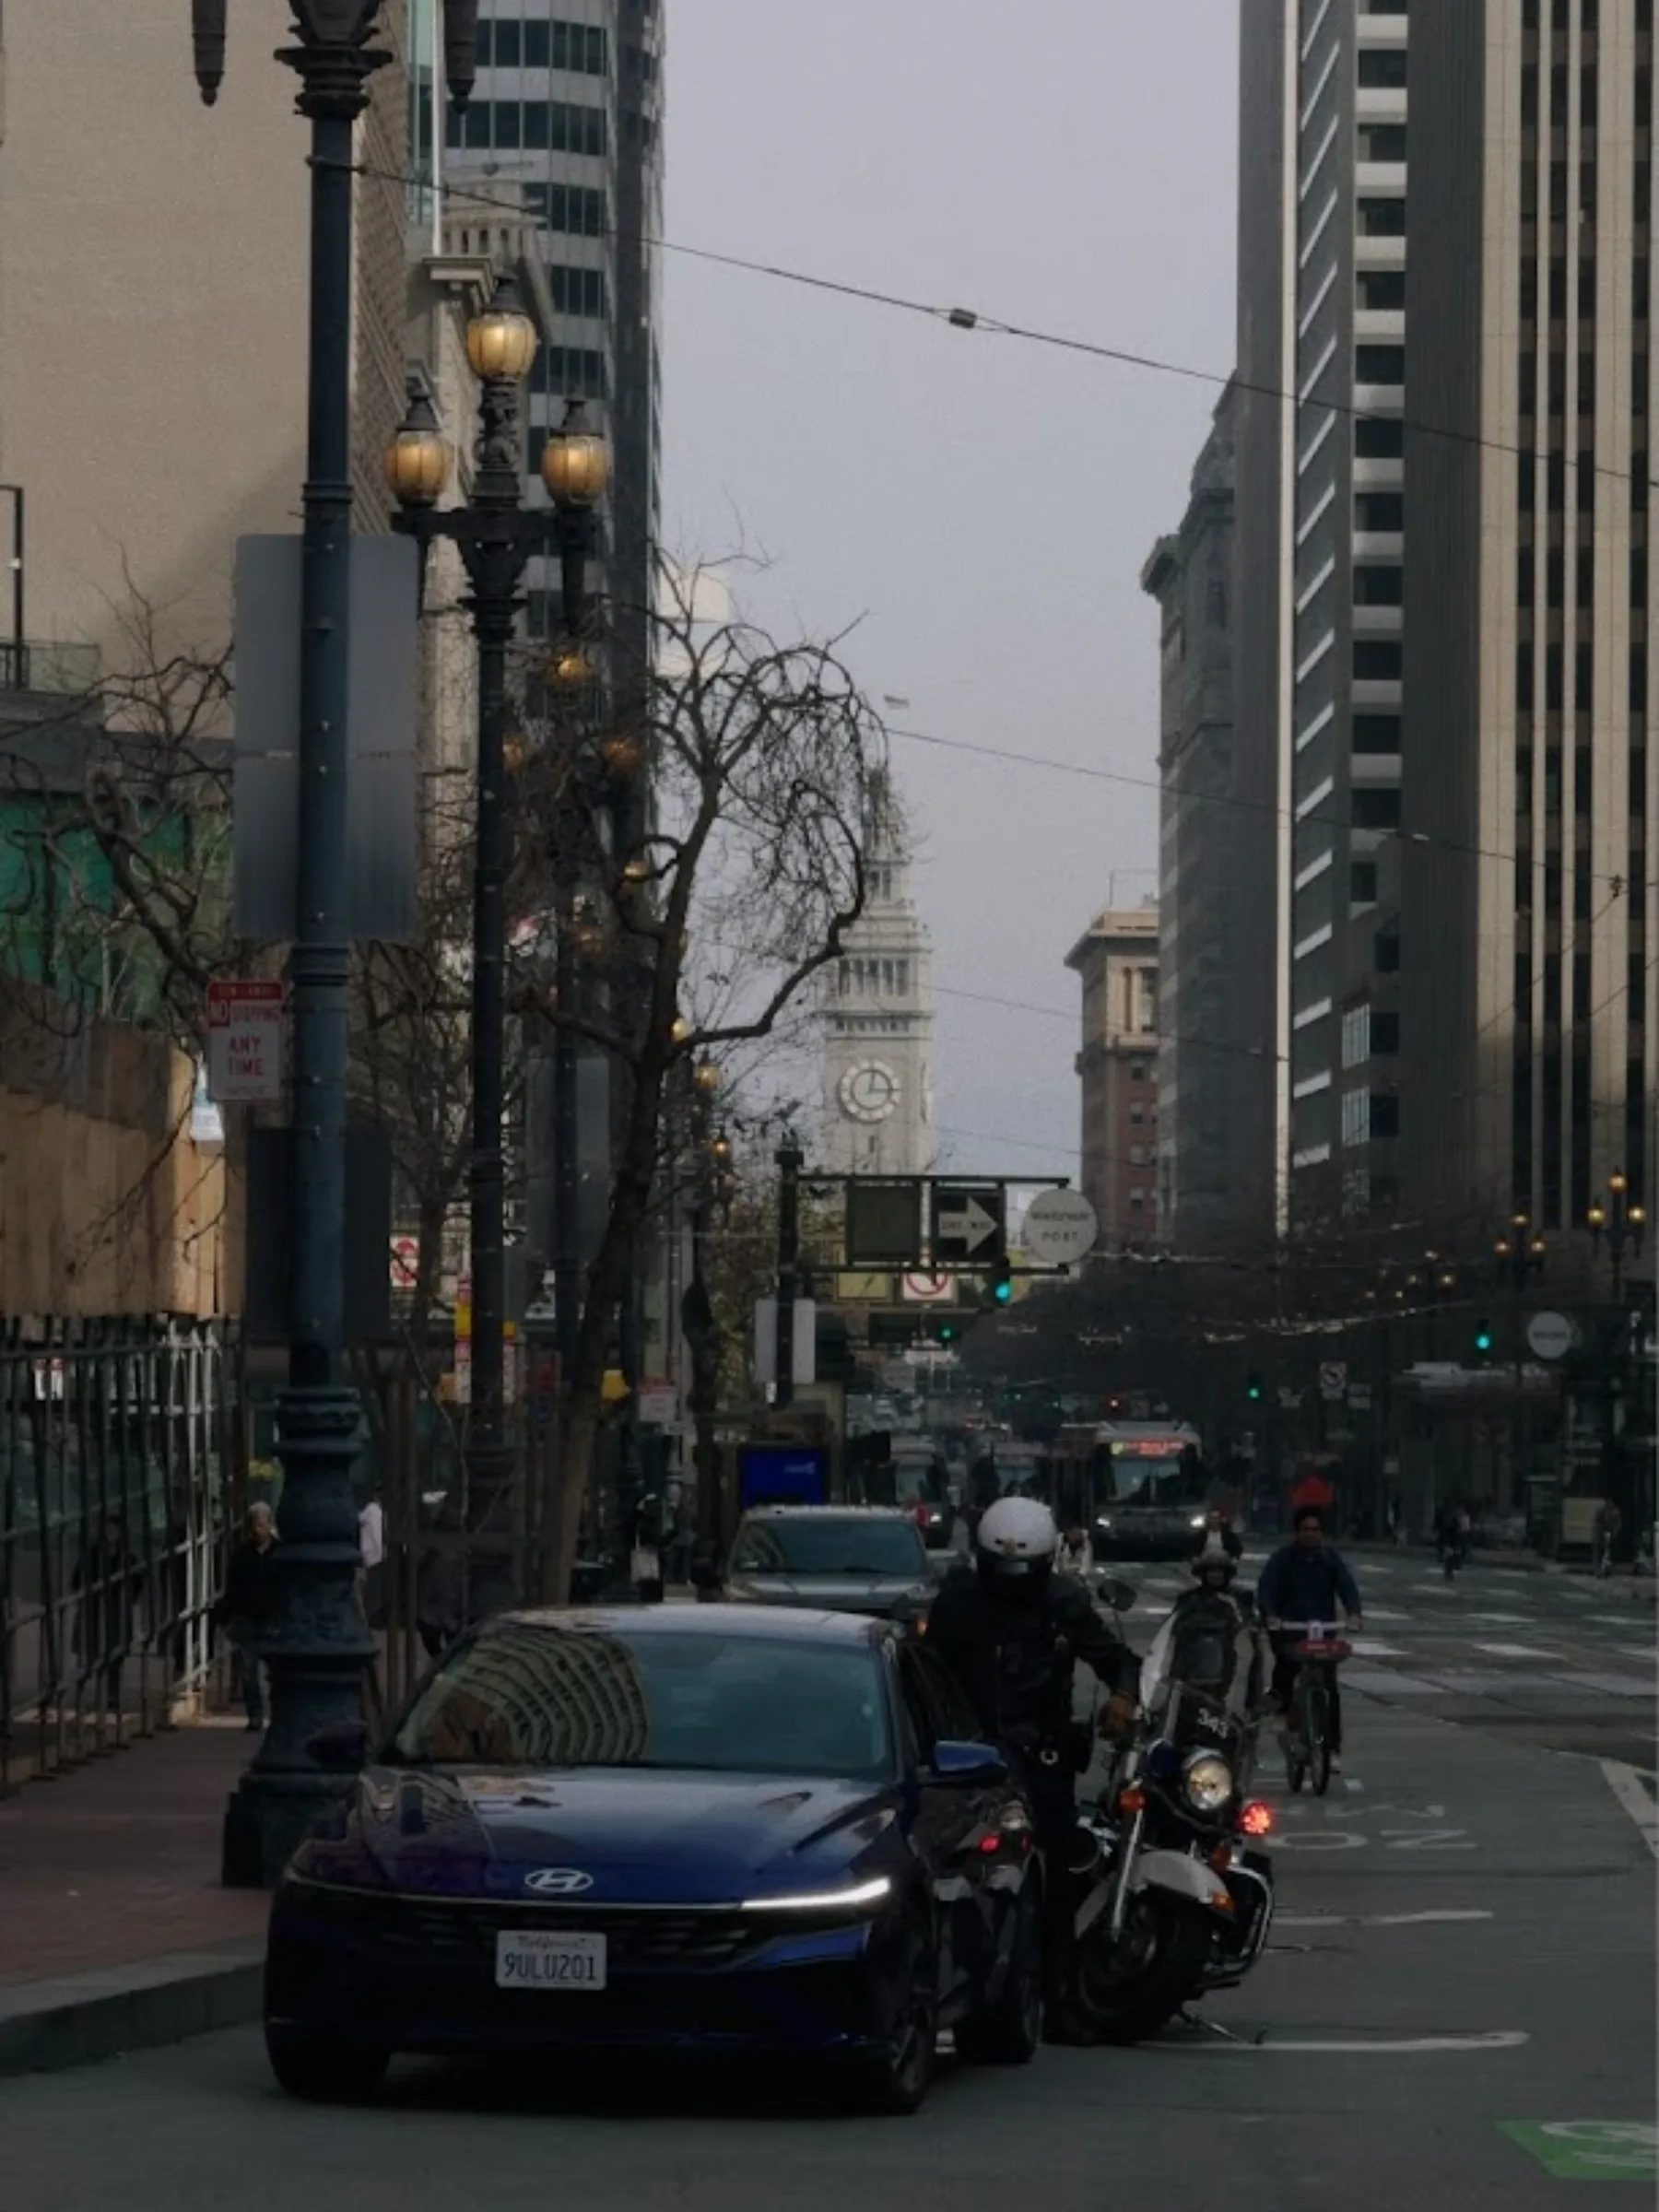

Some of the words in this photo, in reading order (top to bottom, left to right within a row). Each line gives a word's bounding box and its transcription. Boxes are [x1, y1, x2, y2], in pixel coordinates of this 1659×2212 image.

[229, 1035, 262, 1053] ANY
[228, 1057, 264, 1076] TIME
[1041, 1231, 1077, 1242] POST
[504, 1952, 596, 1981] 9ULU201
